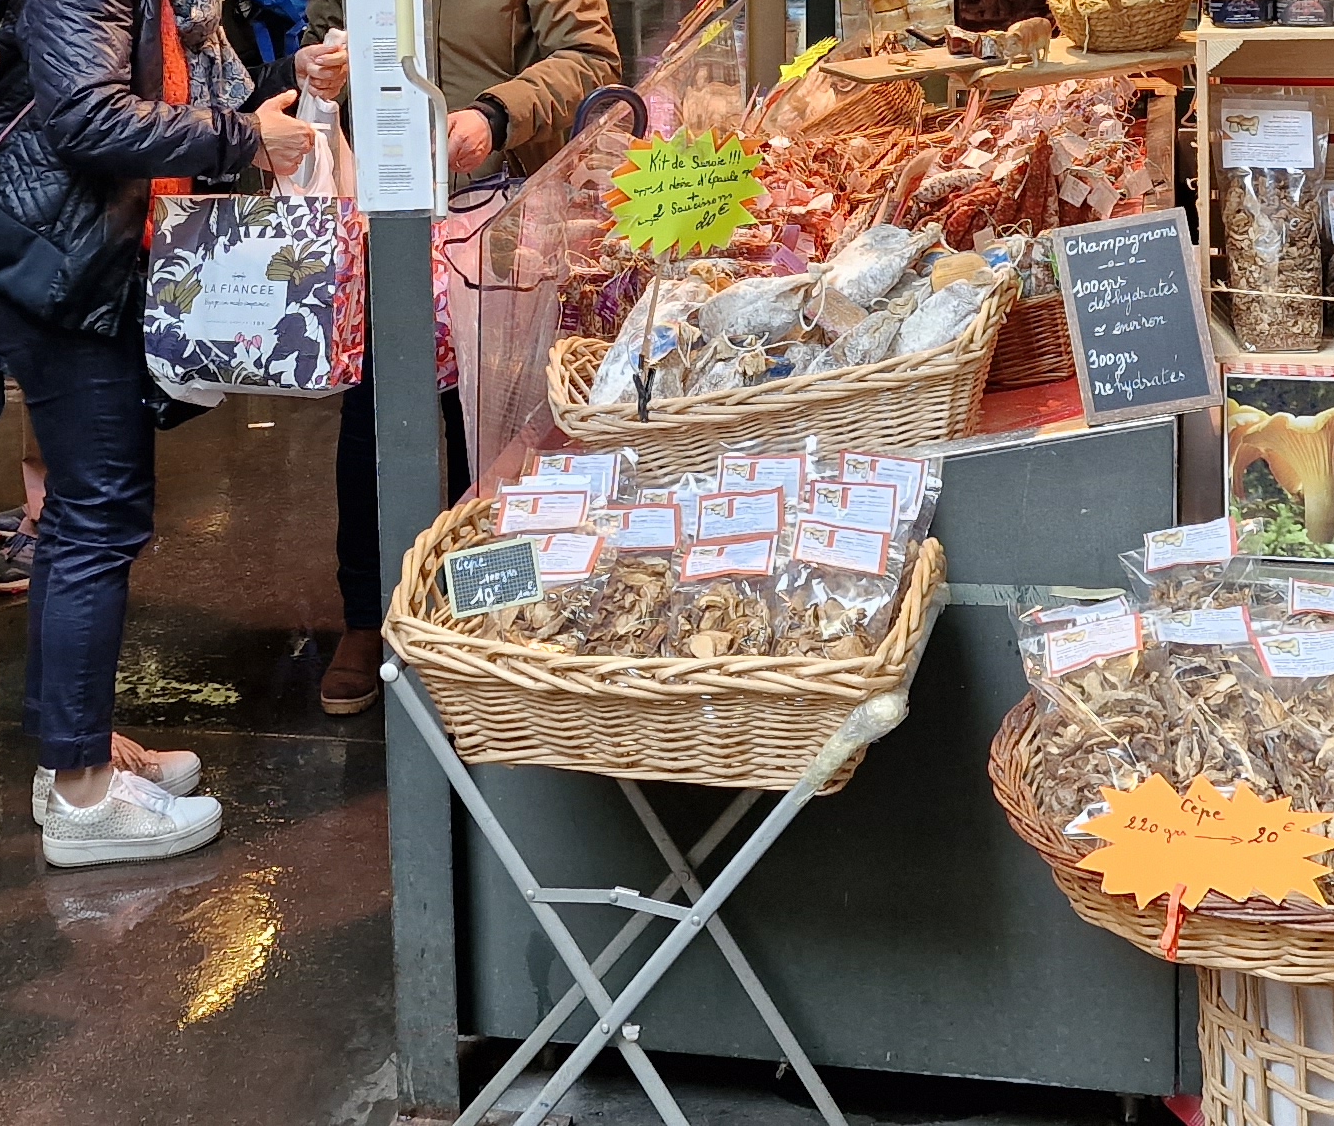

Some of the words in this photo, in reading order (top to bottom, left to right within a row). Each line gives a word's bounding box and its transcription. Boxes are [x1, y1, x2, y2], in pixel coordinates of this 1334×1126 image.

[649, 149, 670, 172] Kit
[672, 155, 685, 170] de
[1065, 225, 1178, 257] Champignons
[204, 284, 217, 294] LA
[1113, 314, 1167, 335] environ
[1088, 348, 1139, 374] 300grs
[1124, 815, 1158, 833] 220
